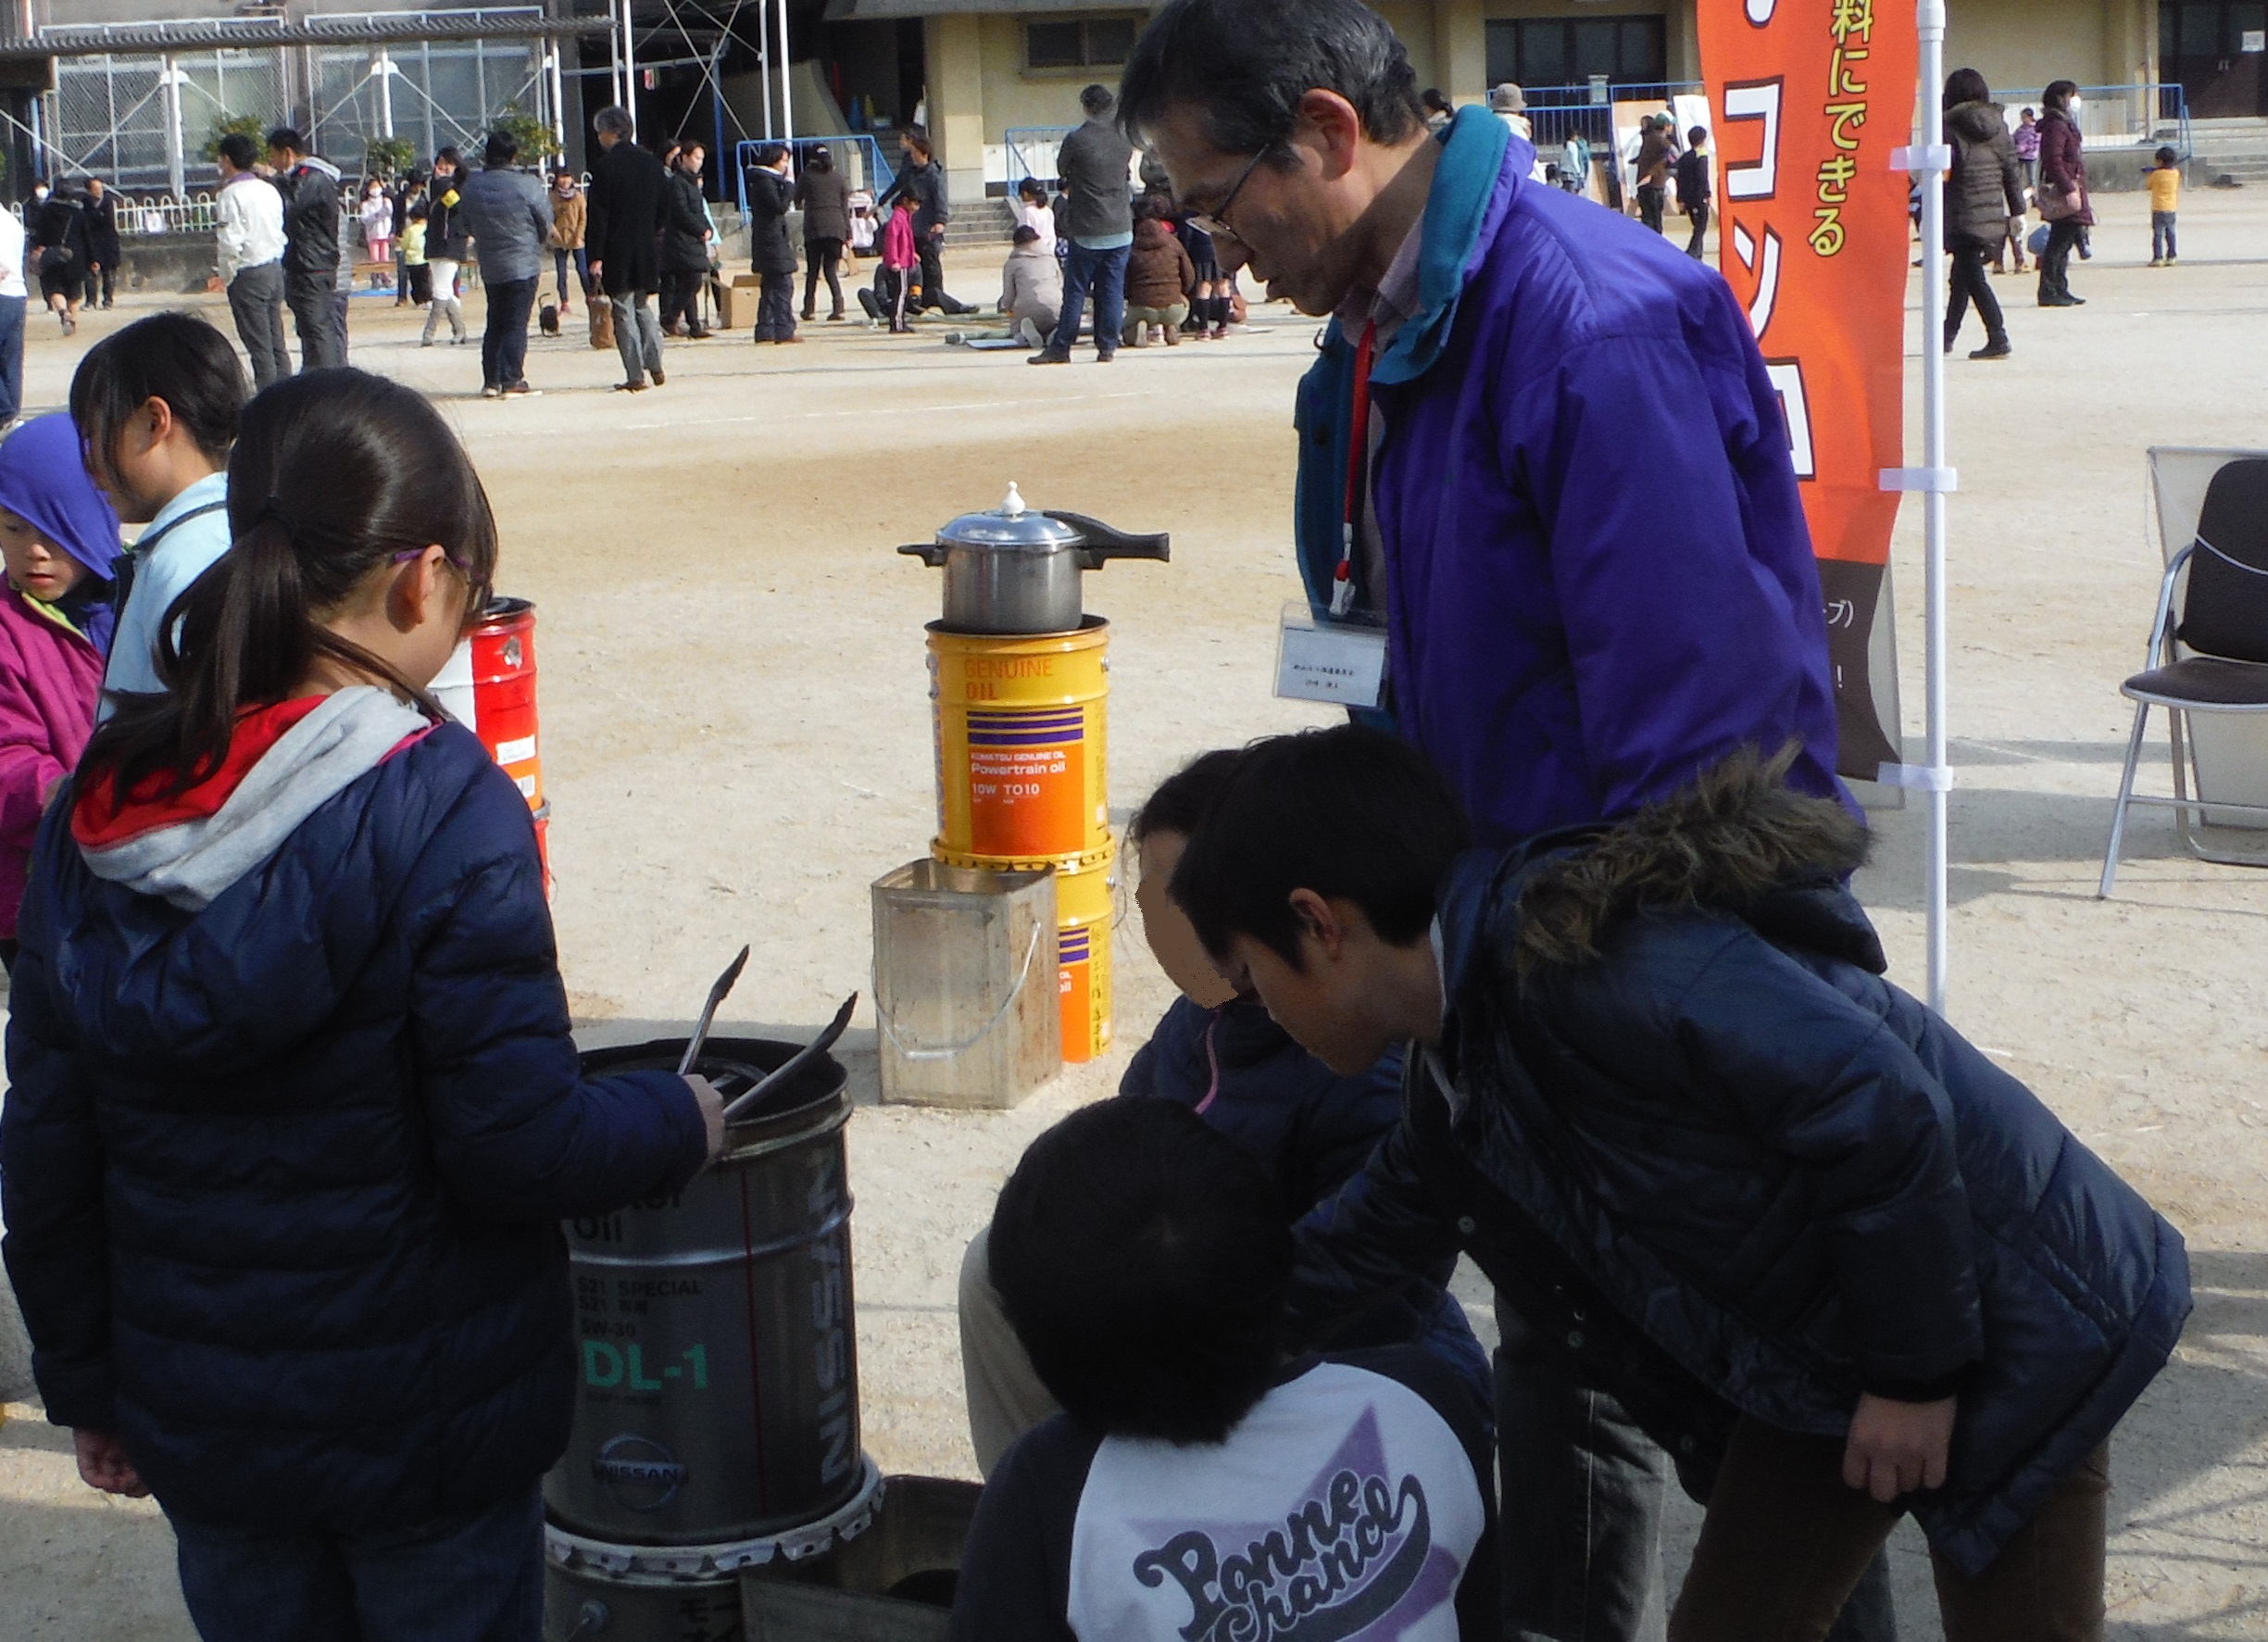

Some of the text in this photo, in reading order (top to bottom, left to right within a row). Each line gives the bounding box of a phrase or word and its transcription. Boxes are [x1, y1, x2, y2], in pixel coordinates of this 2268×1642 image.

[1809, 0, 1873, 257] 料にできる
[1823, 599, 1854, 629] ブ)
[965, 657, 1053, 680] GENUINE
[965, 682, 997, 701] OIL
[1013, 751, 1052, 761] GENUINE
[971, 760, 1066, 775] Powertrain oil
[972, 783, 1040, 796] 10W TO10
[618, 1279, 701, 1297] SPECIAL
[582, 1339, 708, 1390] DL-1
[598, 1464, 679, 1482] NISSAN
